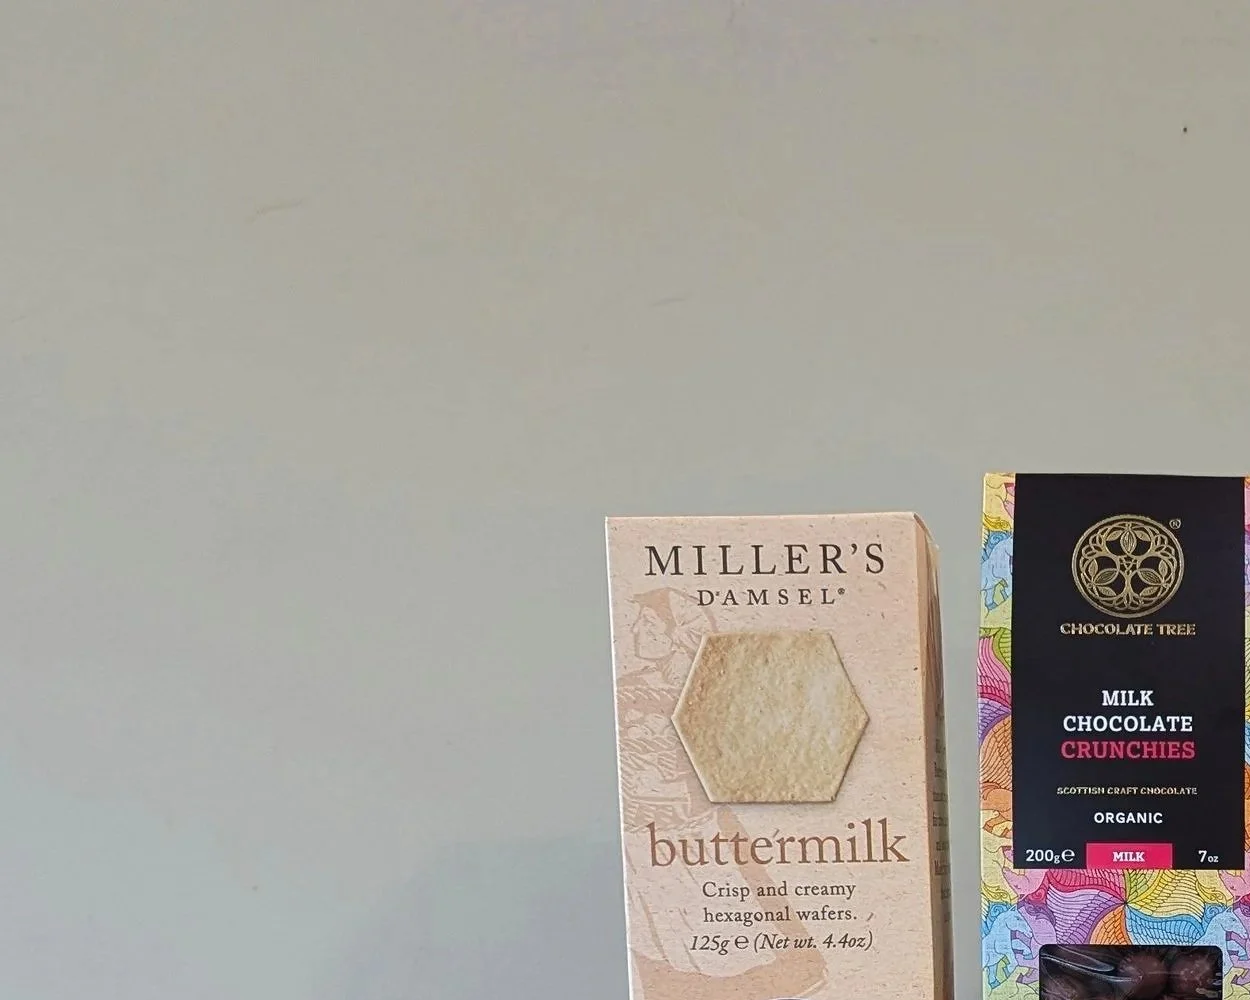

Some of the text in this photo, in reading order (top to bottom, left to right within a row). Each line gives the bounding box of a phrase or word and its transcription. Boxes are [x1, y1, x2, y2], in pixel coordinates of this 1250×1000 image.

[645, 543, 885, 576] MILLER'S
[1060, 623, 1196, 636] CHOCOLATE TREE
[1102, 689, 1154, 707] MILK
[1063, 715, 1193, 733] CHOCOLATE
[1060, 741, 1196, 759] CRUNCHIES
[1056, 786, 1198, 796] SCOTTISH CRAFT CHOCOLATE
[1094, 811, 1163, 824] ORGANIC
[647, 817, 911, 867] buttermilk
[1112, 851, 1145, 862] MILK
[702, 880, 857, 902] Crisp and creamy
[703, 905, 857, 927] hexagonal wafers.
[754, 932, 790, 953] (Net
[794, 935, 817, 949] wt.
[822, 930, 873, 951] 4.4oz)
